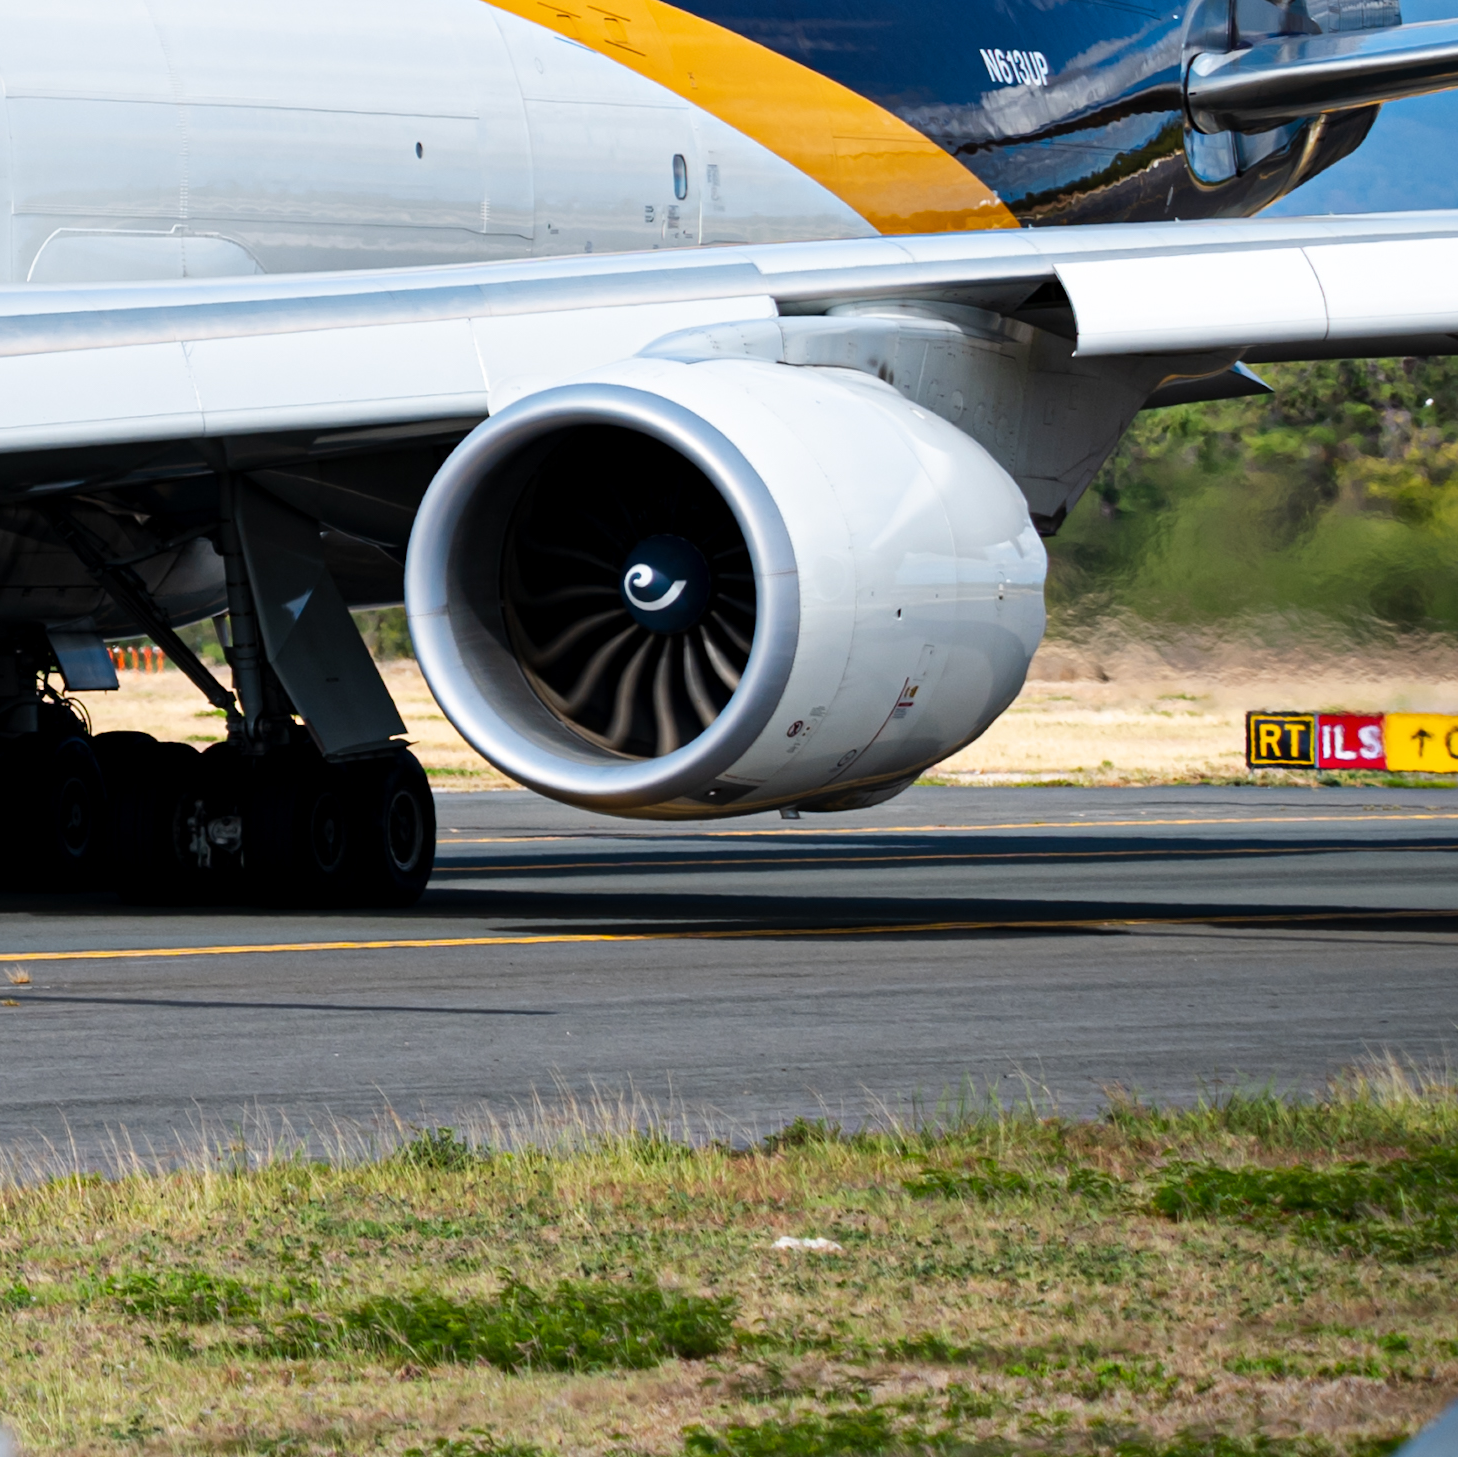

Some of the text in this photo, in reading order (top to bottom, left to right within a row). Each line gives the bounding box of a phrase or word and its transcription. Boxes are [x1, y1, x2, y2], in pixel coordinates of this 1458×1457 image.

[979, 48, 1049, 86] N613UP
[1258, 723, 1383, 760] RT ILS
